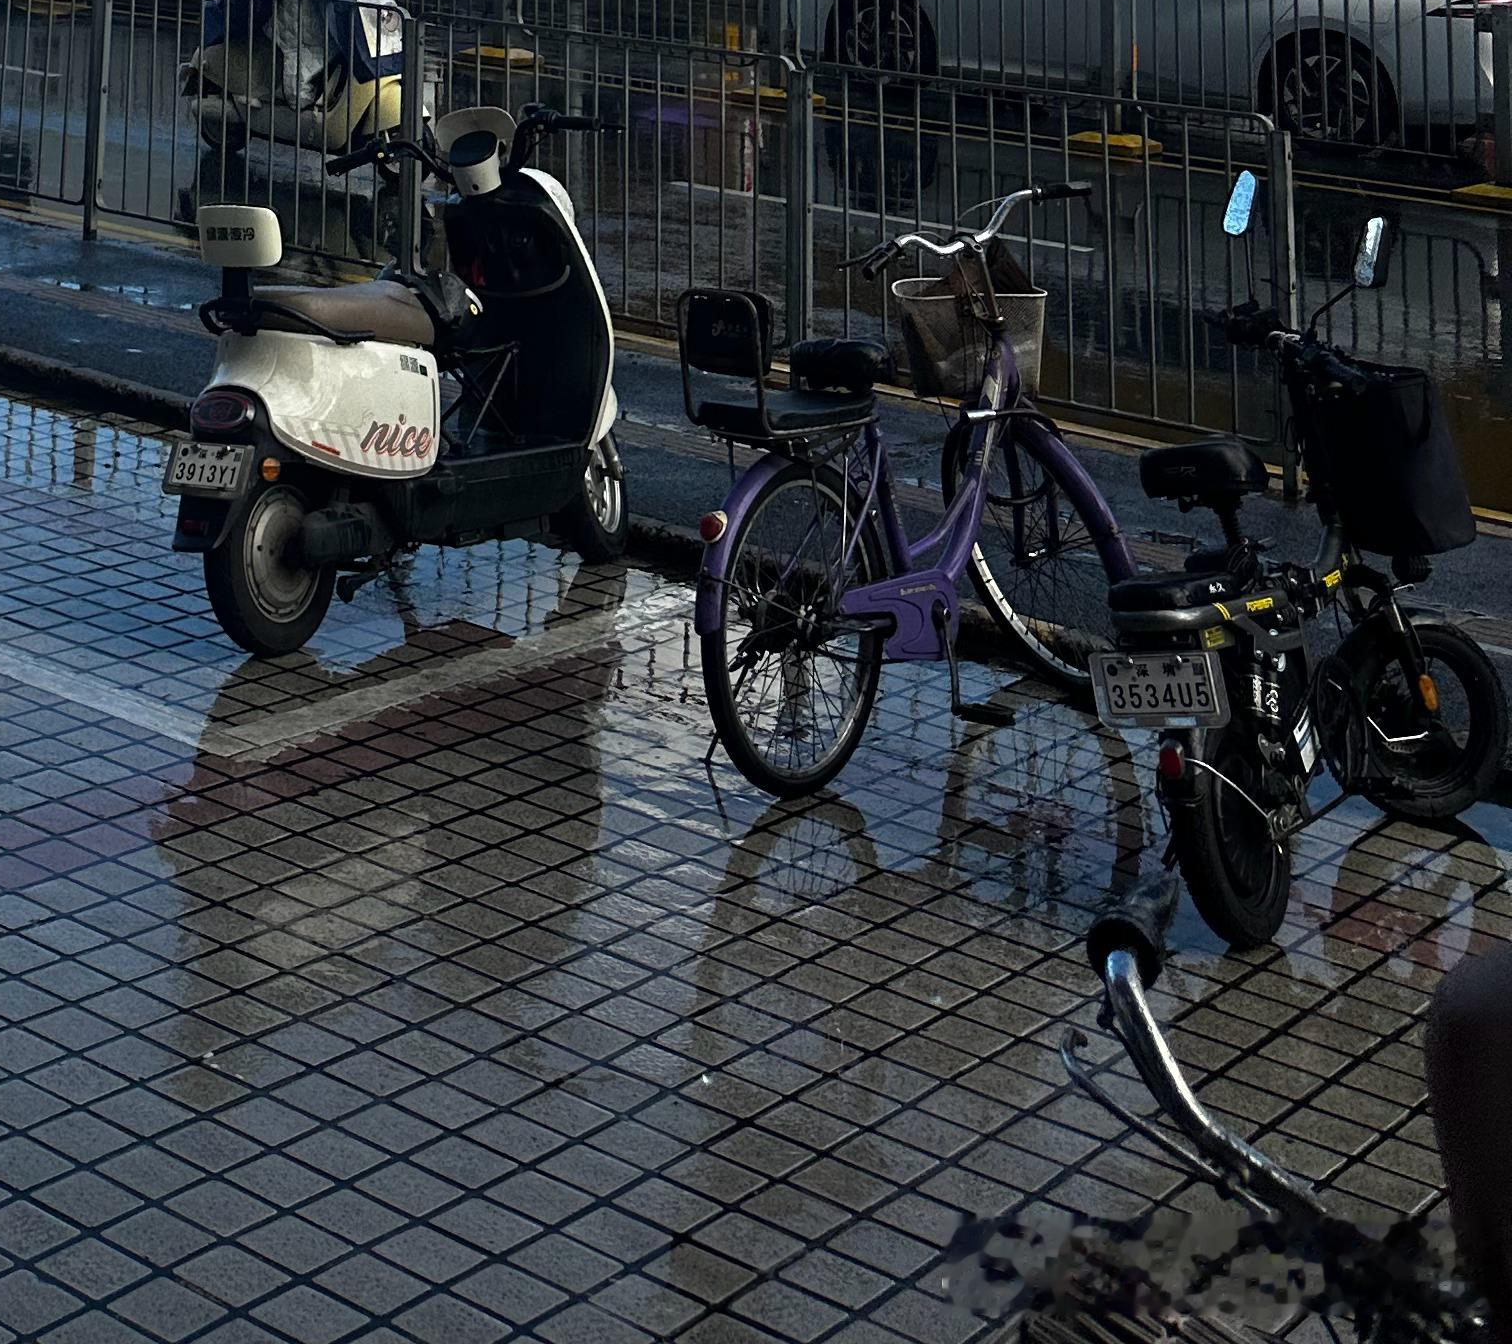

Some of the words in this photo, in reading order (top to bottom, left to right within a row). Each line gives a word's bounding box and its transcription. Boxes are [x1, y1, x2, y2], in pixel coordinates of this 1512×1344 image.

[360, 413, 432, 459] nice
[175, 462, 237, 485] 3913Y1
[1135, 662, 1176, 678] 深圳
[1112, 682, 1210, 709] 3534U5
